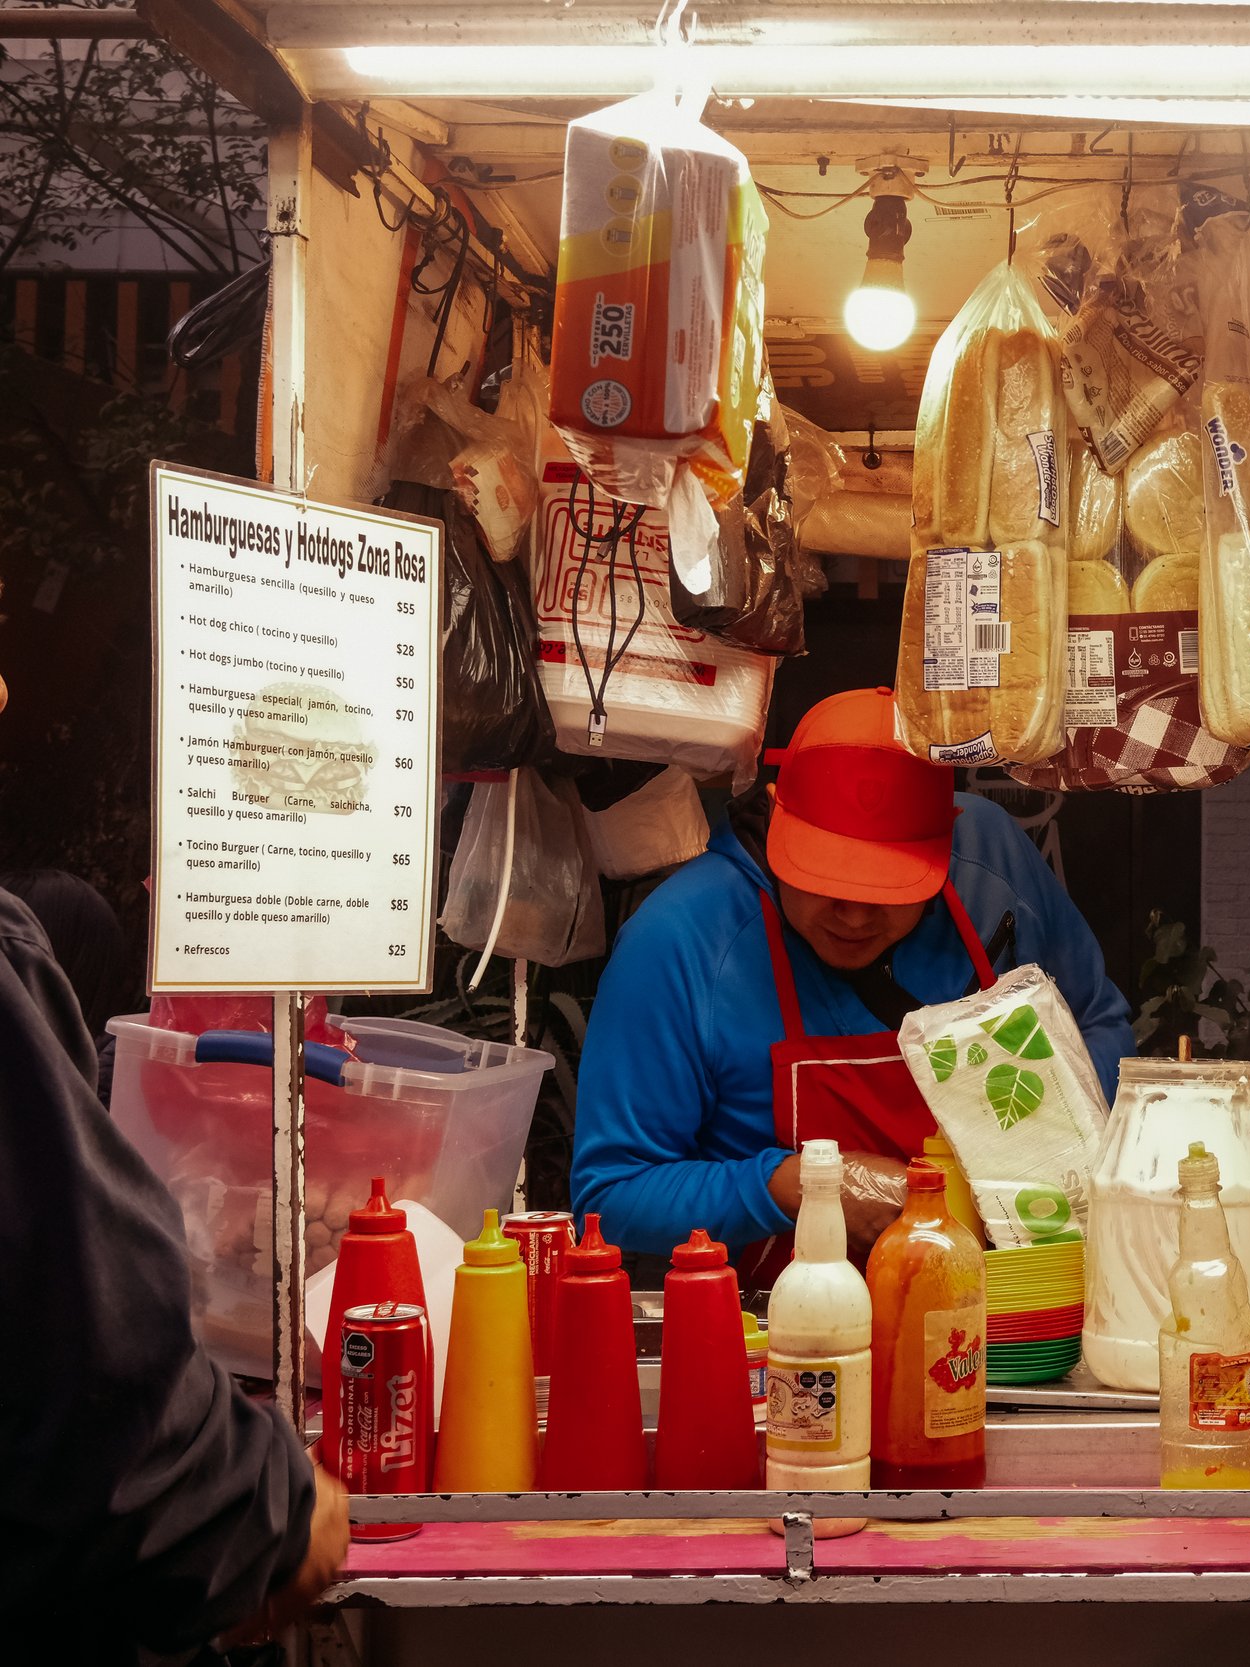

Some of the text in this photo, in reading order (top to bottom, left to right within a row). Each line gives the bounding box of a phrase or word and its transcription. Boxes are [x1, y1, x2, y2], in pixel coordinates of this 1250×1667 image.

[600, 305, 624, 356] 250
[622, 305, 633, 358] SERVILLETAS
[1131, 346, 1170, 378] rico sabor
[1036, 444, 1051, 484] Wonder
[1207, 418, 1234, 491] WONDER
[168, 494, 426, 583] Hamburguesas y Hotdogs Zona Rosa
[189, 563, 374, 606] Hamburguesa sencilla (quesillo y queso
[189, 581, 233, 598] amarillo)
[397, 602, 415, 615] $55
[189, 615, 338, 648] Hot dog chico tocino y quesillo)
[396, 644, 414, 657] $28
[189, 649, 345, 681] Hot dogs jumbo (tocino y quesillo)
[396, 677, 414, 690] $50
[189, 684, 374, 717] Hamburguesa especial( jamón, tocino,
[189, 701, 308, 726] quesillo y queso amarillo)
[396, 709, 414, 722] $70
[187, 735, 373, 765] Jamón Hamburguer( con jamón, quesillo
[188, 754, 270, 771] y queso amarillo)
[395, 757, 413, 770] $60
[187, 788, 372, 813] Salchi Burguer (Carne, salchicha,
[187, 805, 307, 824] quesillo y queso amarillo)
[394, 805, 412, 818] $70
[186, 839, 371, 862] Tocino Burguer Carne, tocino, quesillo y
[392, 853, 410, 866] $65
[186, 858, 261, 872] queso amarillo)
[186, 892, 369, 909] Hamburguesa doble (Doble carne, doble
[391, 899, 408, 912] $85
[185, 910, 330, 925] quesillo y doble queso amarillo)
[184, 944, 230, 955] Refrescos
[388, 945, 406, 956] $25
[380, 1370, 417, 1473] Lizet
